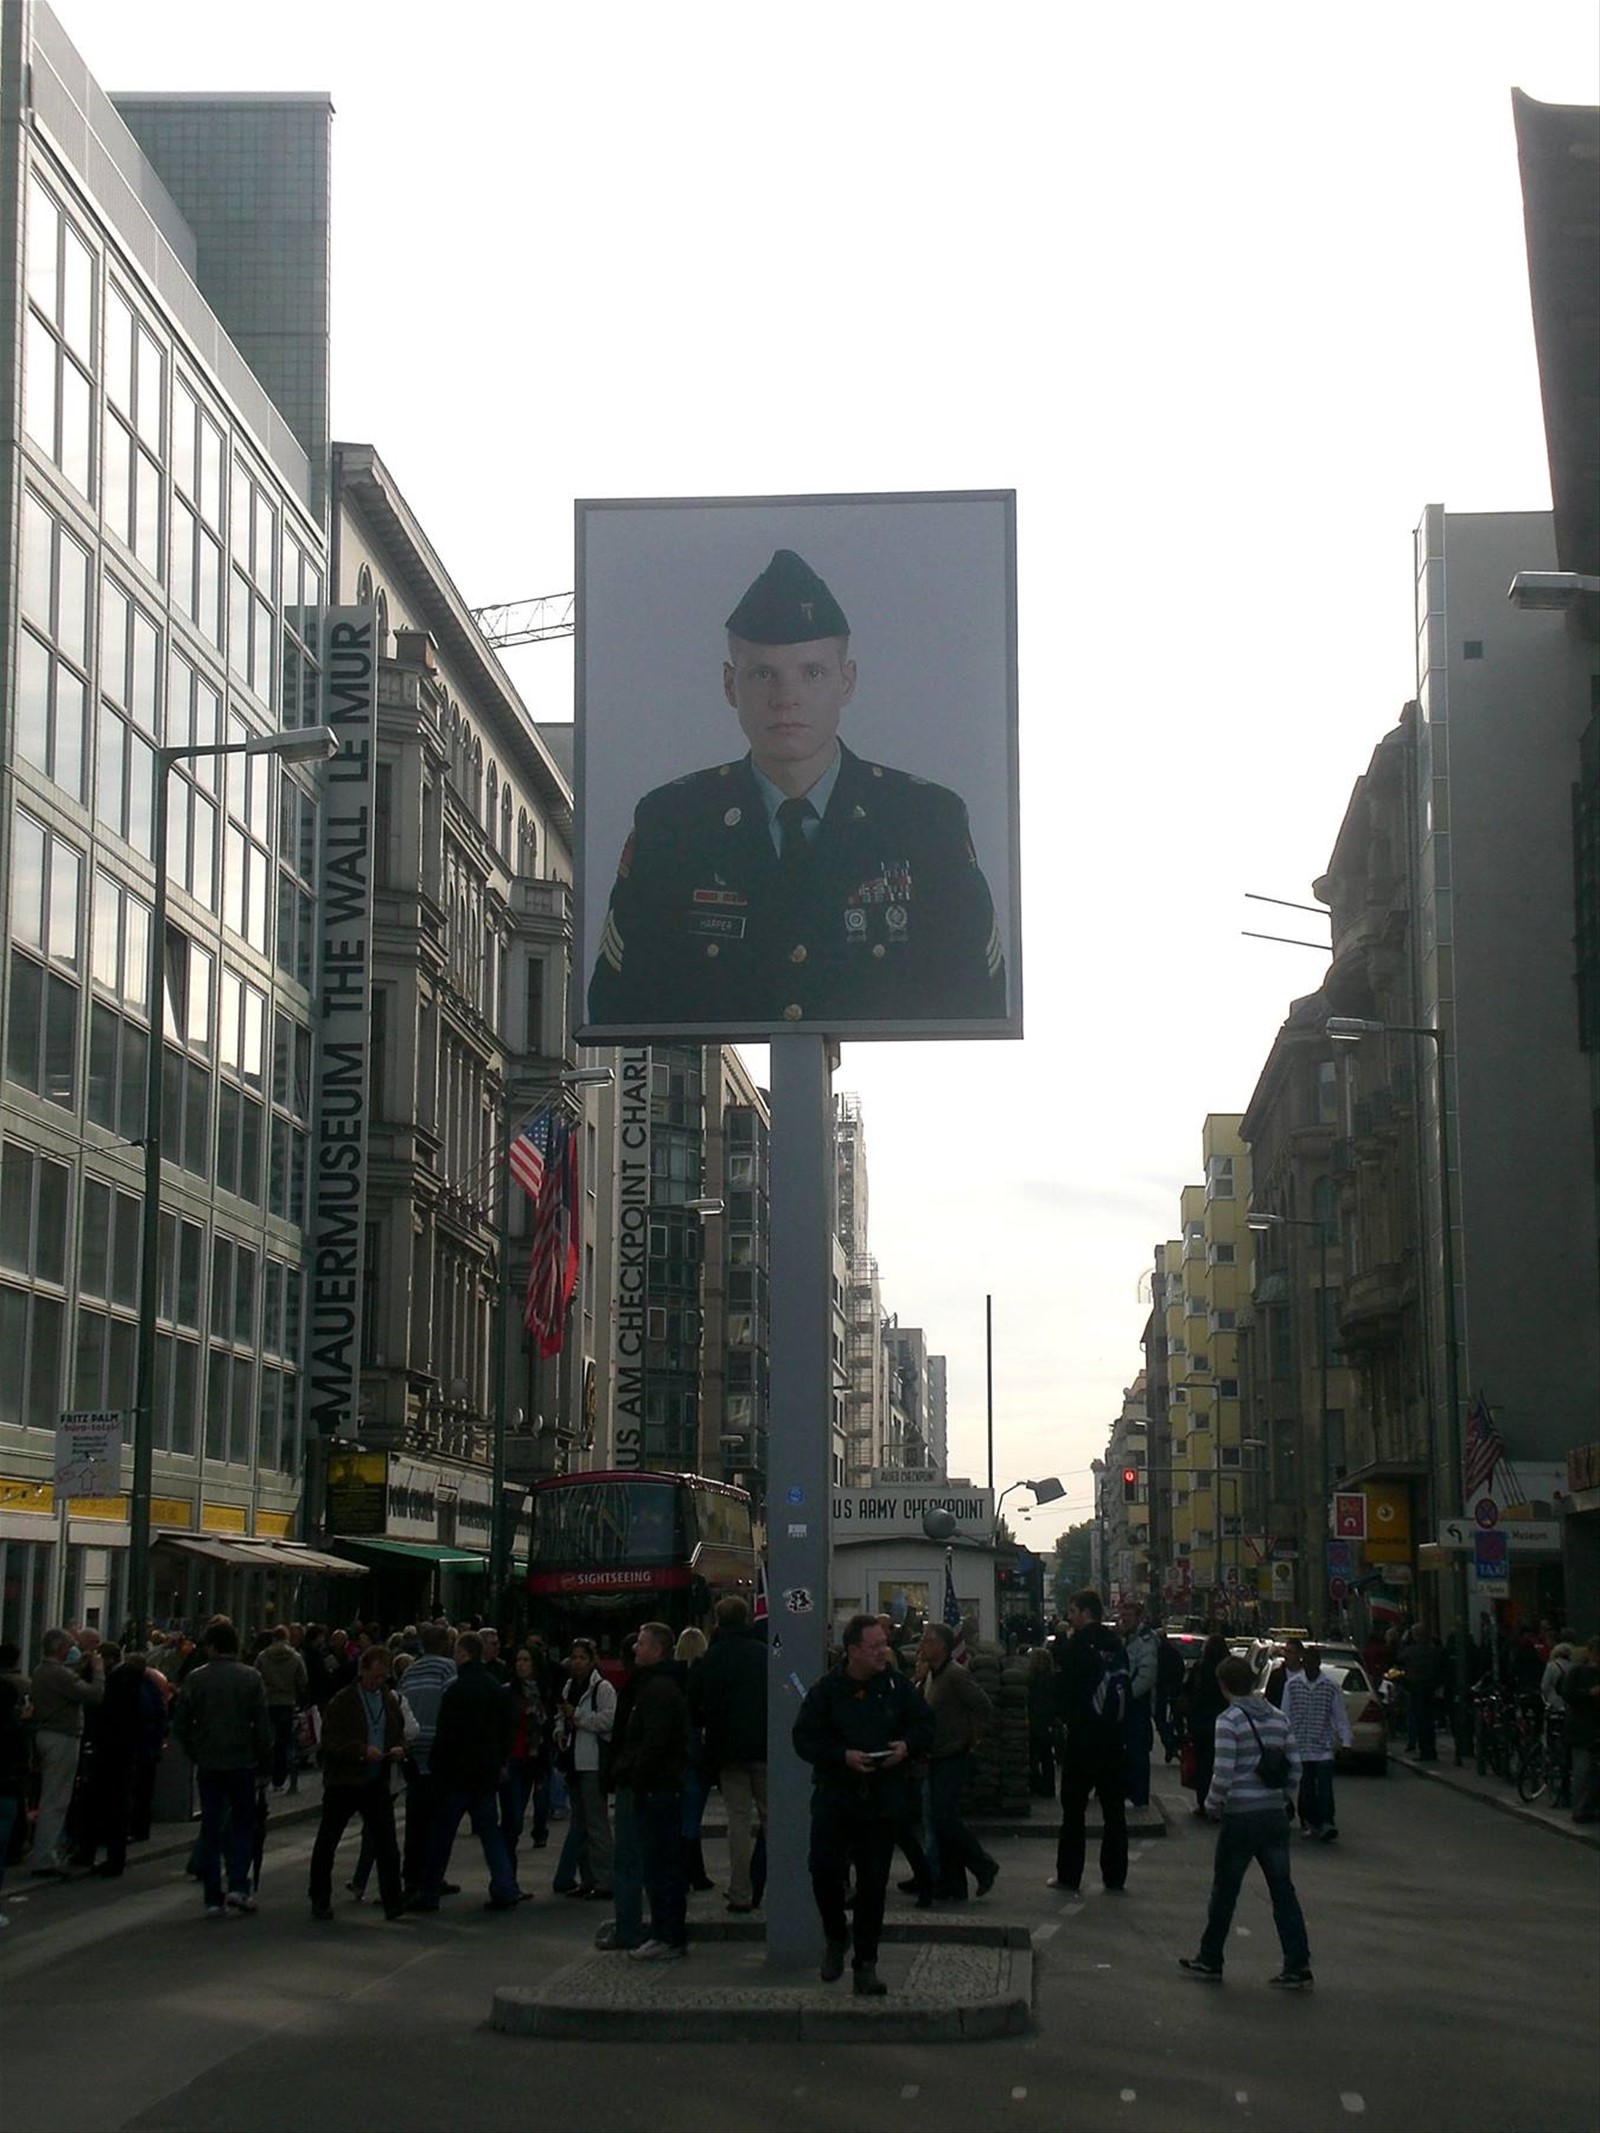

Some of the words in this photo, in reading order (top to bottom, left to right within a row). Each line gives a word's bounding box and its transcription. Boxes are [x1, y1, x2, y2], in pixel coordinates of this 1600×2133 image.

[331, 621, 371, 724] MUR
[329, 739, 369, 782] LE
[325, 806, 367, 926] WALL
[323, 939, 364, 1018] THE
[311, 1043, 363, 1419] MAUERMUSEUM
[619, 1158, 646, 1356] CHECKPOINT
[618, 1366, 643, 1417] AM
[616, 1428, 642, 1470] US
[833, 1499, 852, 1518] US
[859, 1499, 897, 1519] ARMY
[577, 1571, 652, 1584] SIGHTSEEING
[1479, 1563, 1506, 1576] TAXI
